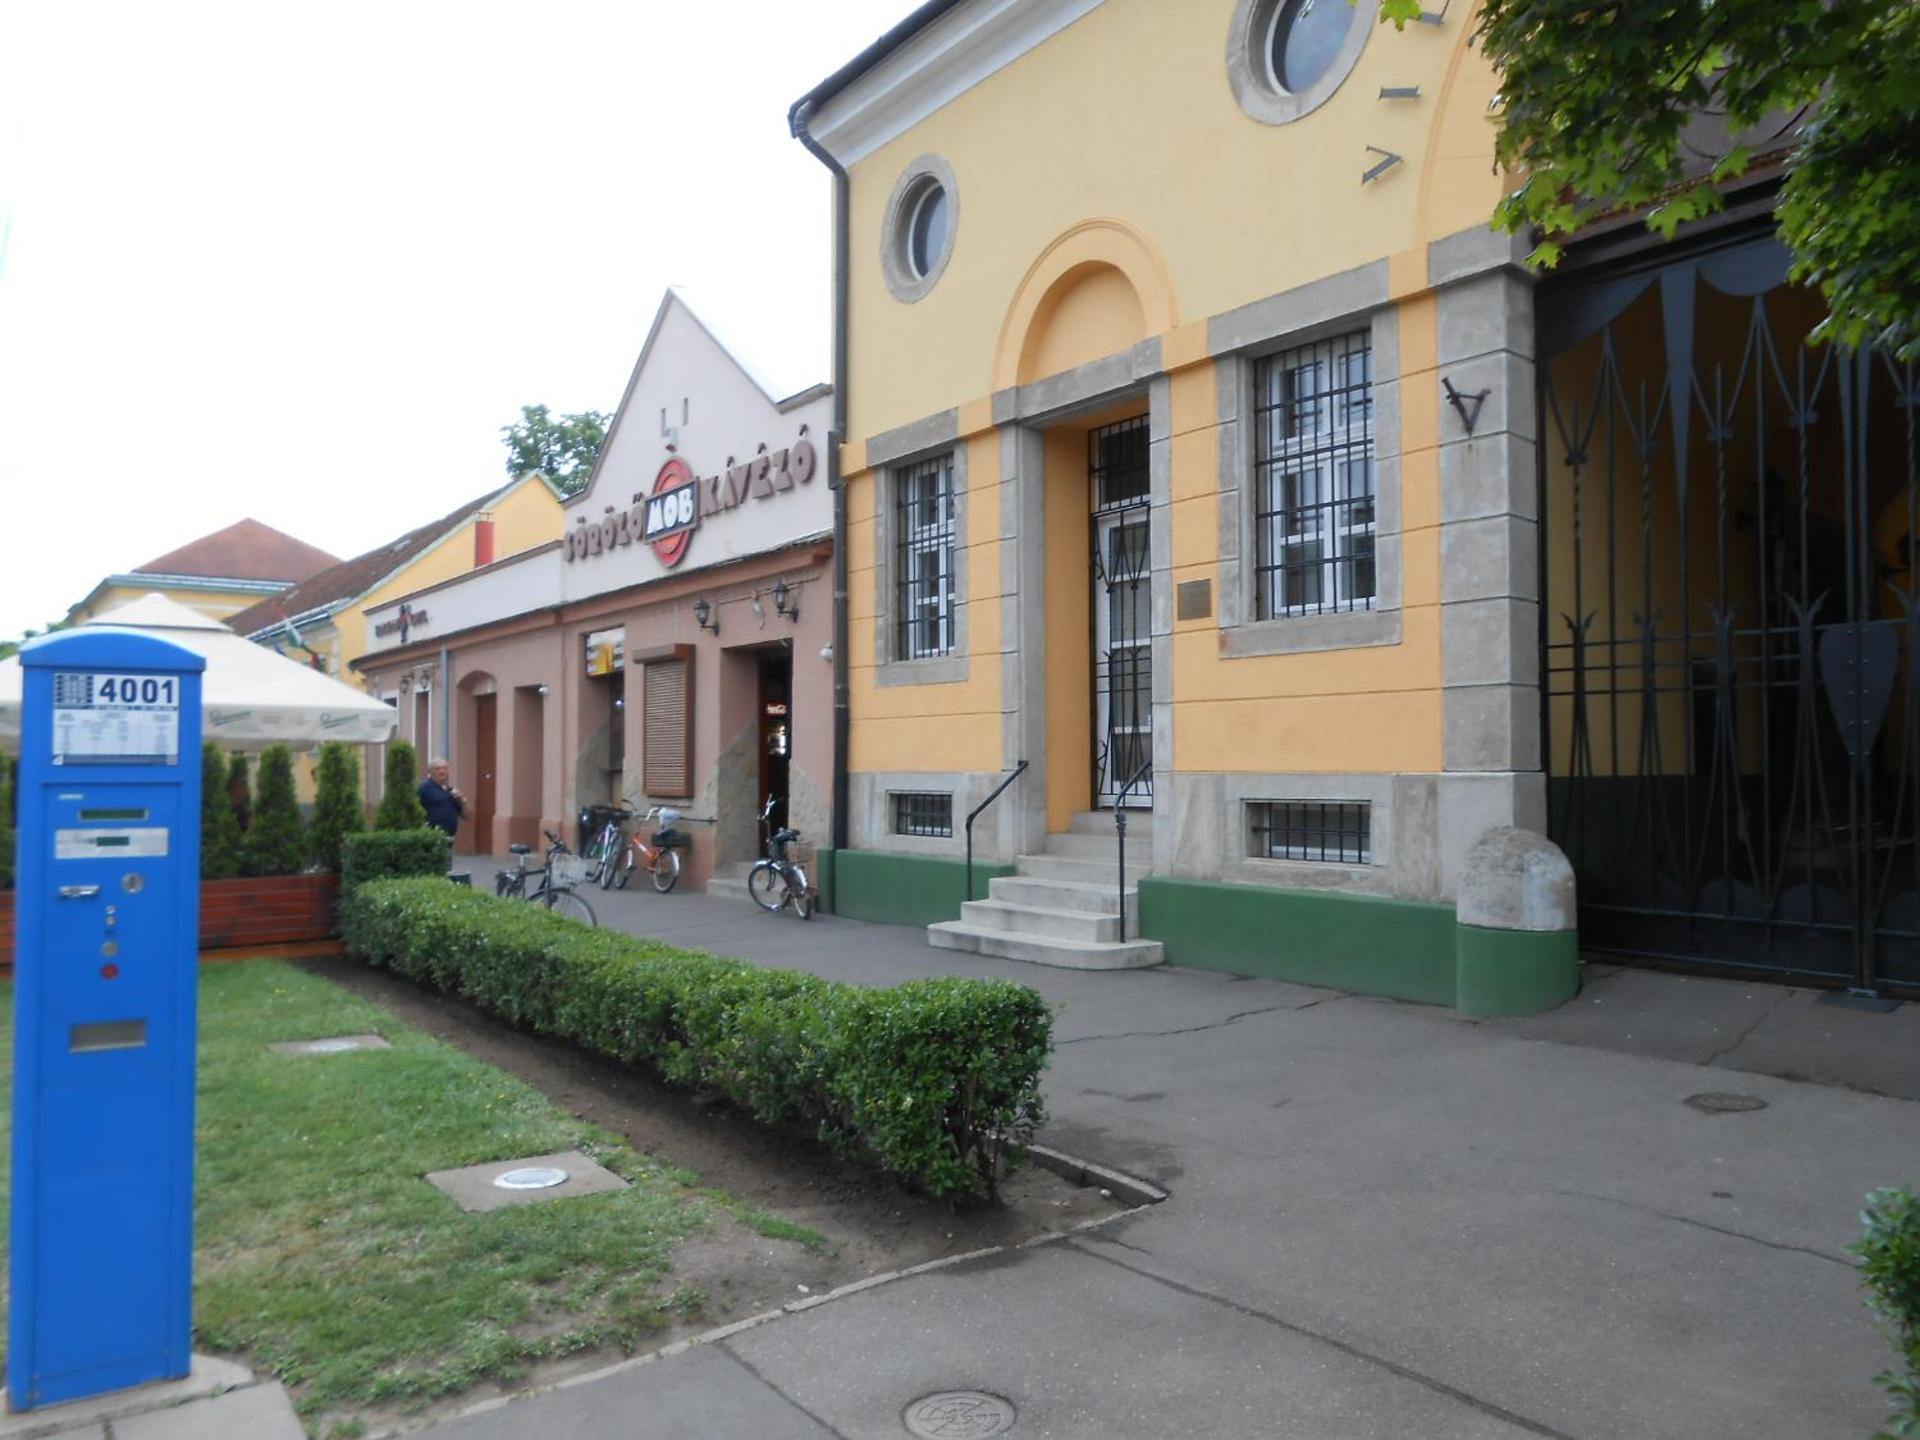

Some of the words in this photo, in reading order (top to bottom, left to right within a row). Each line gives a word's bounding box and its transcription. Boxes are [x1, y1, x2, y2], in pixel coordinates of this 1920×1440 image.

[647, 488, 694, 534] MOB
[699, 424, 816, 518] KÁVÉZÓ
[100, 678, 173, 703] 4001
